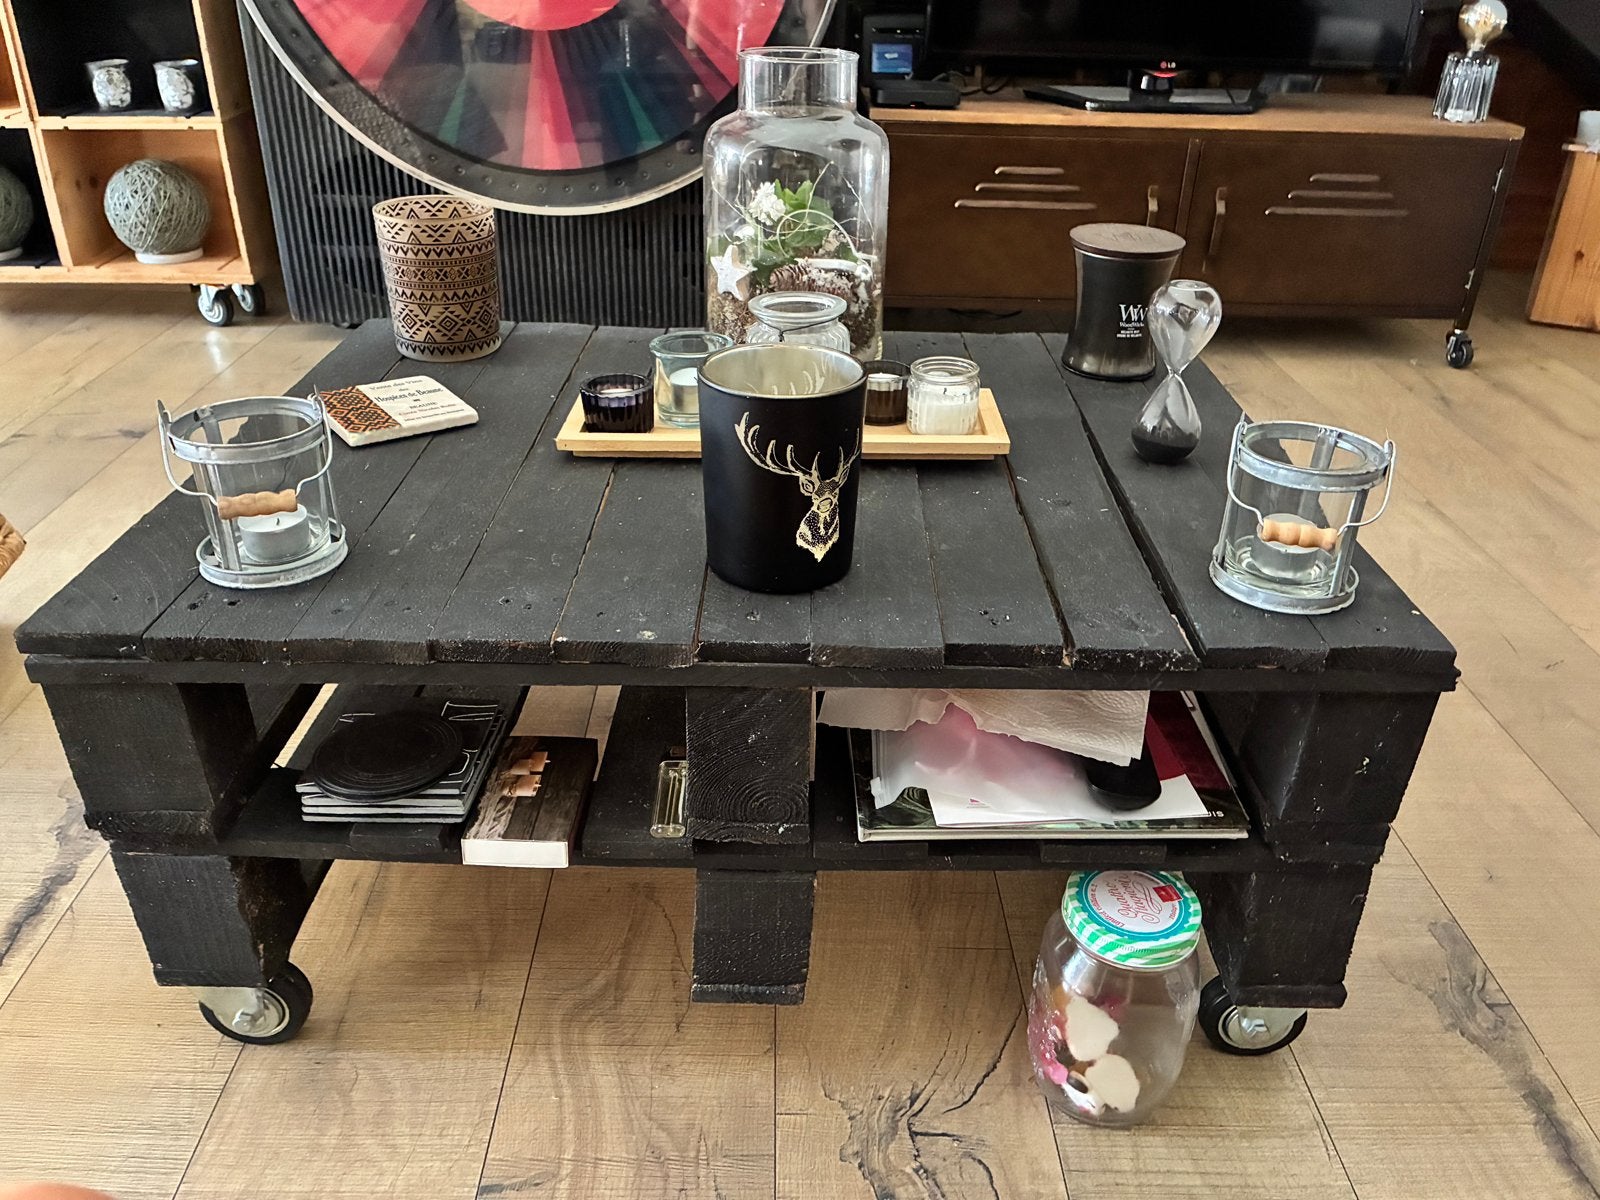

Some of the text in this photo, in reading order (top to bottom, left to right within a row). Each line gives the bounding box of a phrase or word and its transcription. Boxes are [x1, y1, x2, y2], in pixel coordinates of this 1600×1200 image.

[375, 393, 407, 402] Hospices
[416, 387, 443, 395] Beaune
[1105, 881, 1138, 919] Quattro
[1118, 873, 1161, 924] Stagioni
